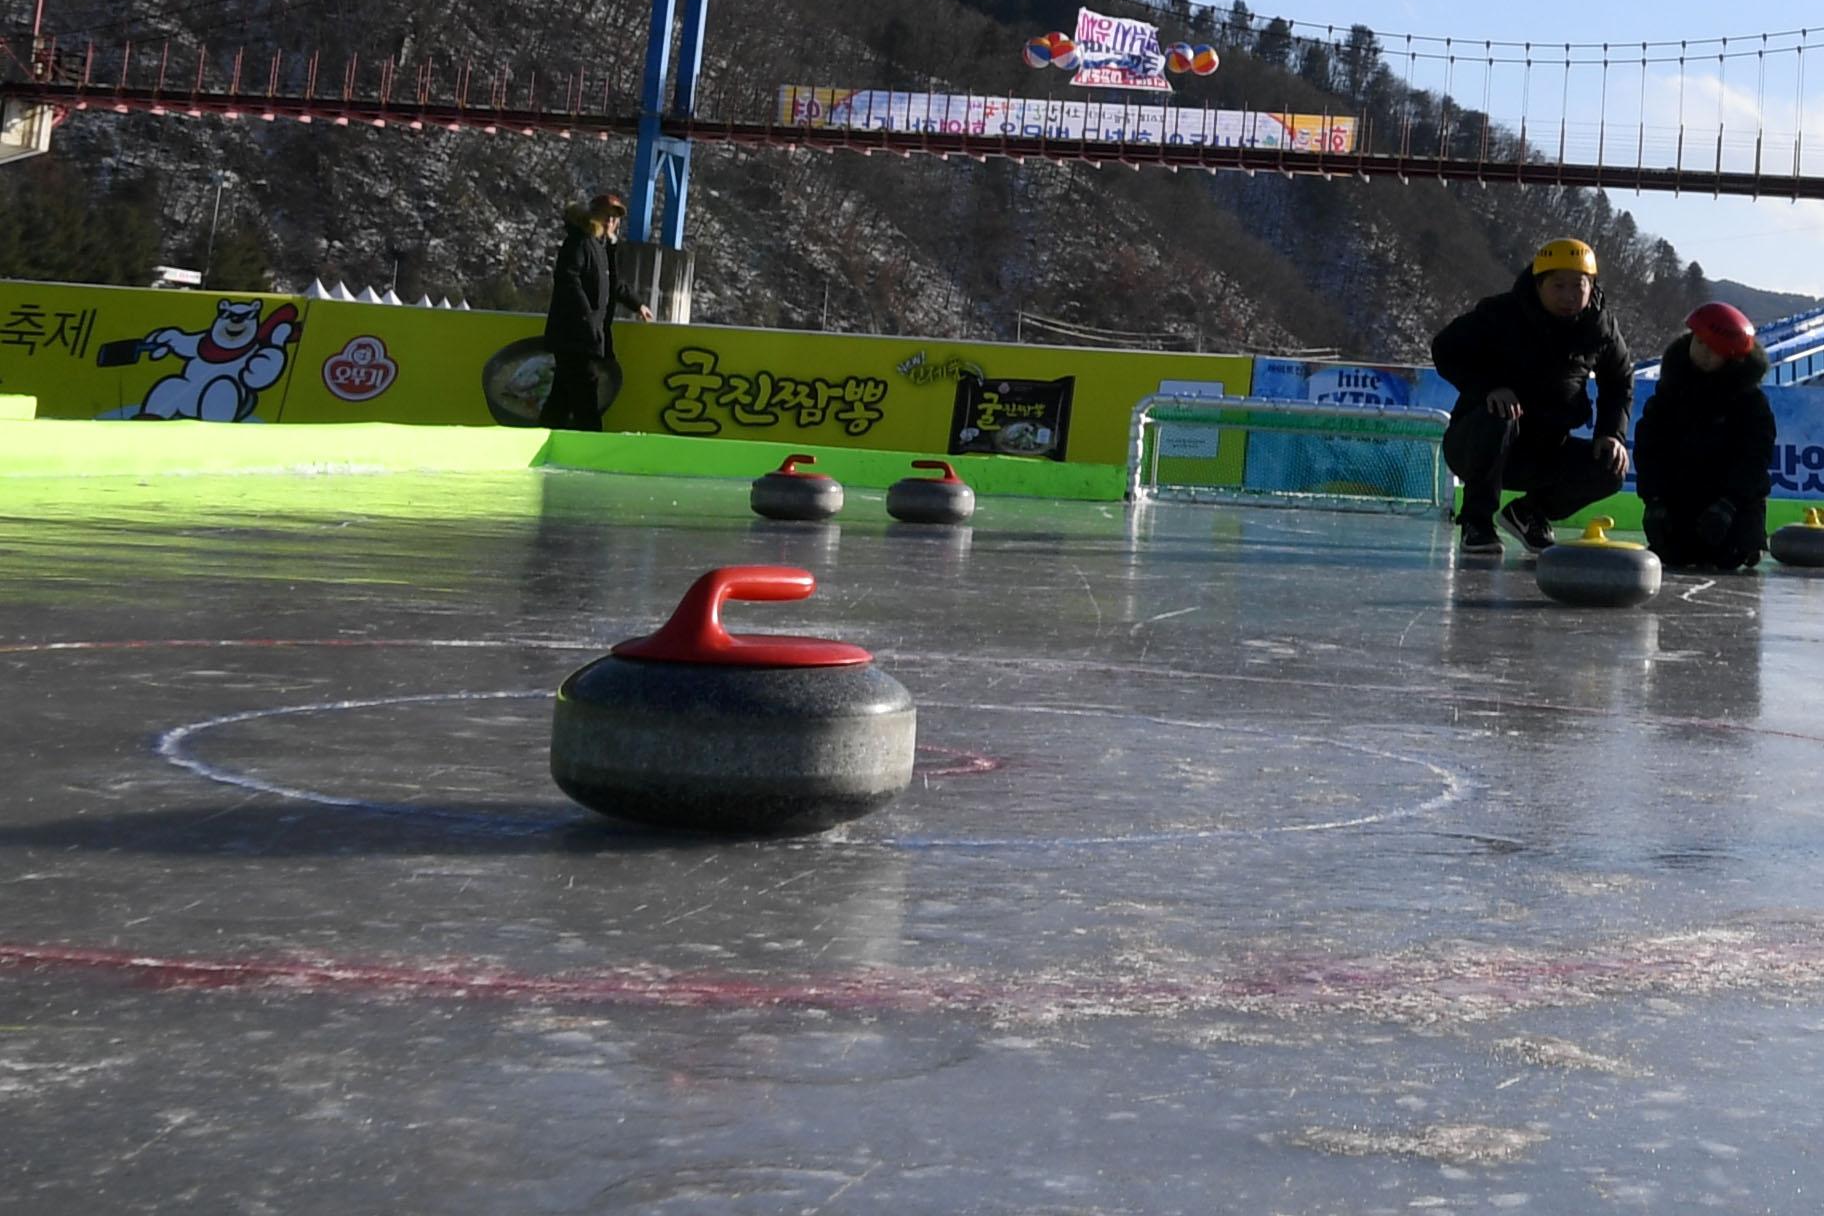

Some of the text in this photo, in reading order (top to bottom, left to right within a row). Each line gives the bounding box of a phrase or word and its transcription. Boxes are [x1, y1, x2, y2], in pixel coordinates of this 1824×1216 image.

[0, 303, 97, 359] 축제
[333, 365, 385, 388] 오뚜기
[660, 347, 888, 437] 굴진짬뽕
[1337, 369, 1382, 390] hite
